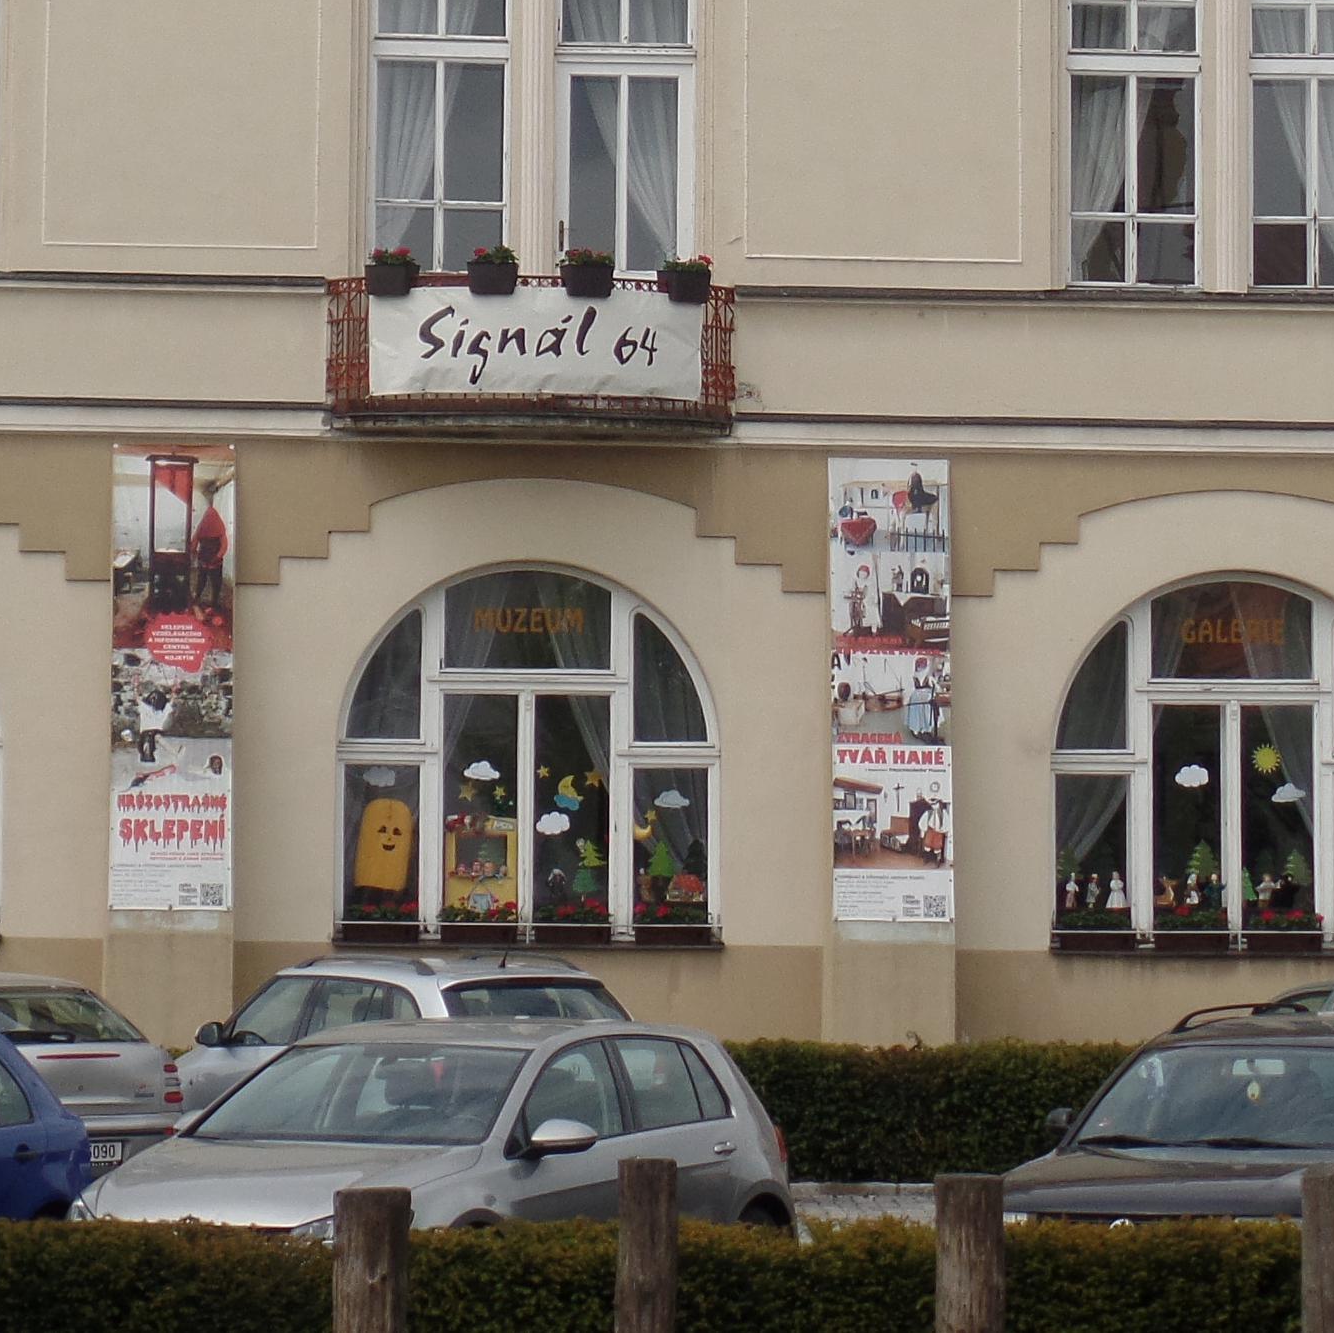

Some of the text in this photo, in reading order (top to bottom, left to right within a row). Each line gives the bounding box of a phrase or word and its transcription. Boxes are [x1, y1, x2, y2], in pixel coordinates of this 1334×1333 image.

[418, 305, 658, 385] Signál 64
[474, 607, 585, 636] MUZEUM
[1180, 617, 1285, 646] GALERIE
[836, 747, 945, 765] TVÁŘ HANÉ
[118, 814, 226, 850] SKLEPENÍ
[89, 1144, 116, 1159] 090
